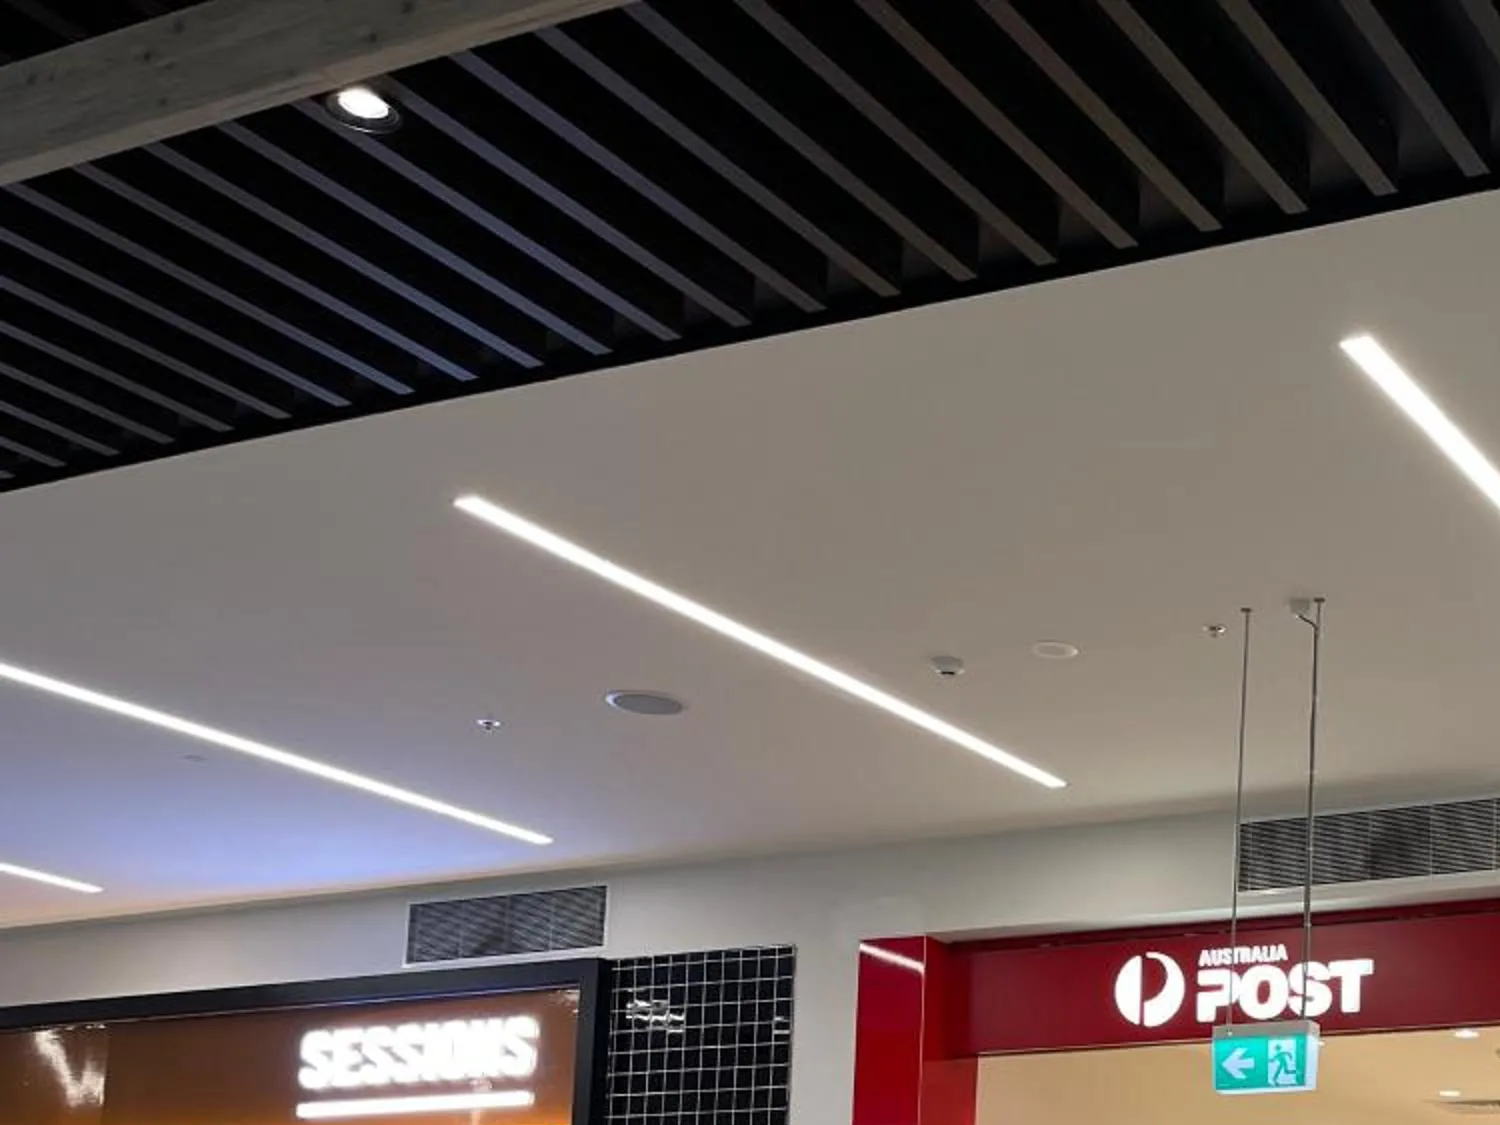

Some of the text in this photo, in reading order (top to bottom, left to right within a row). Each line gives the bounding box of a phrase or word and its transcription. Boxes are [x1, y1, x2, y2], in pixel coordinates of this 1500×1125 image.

[1198, 944, 1289, 967] AUSTRALIA
[1196, 958, 1374, 1023] POST
[299, 1017, 539, 1088] SESSIONS
